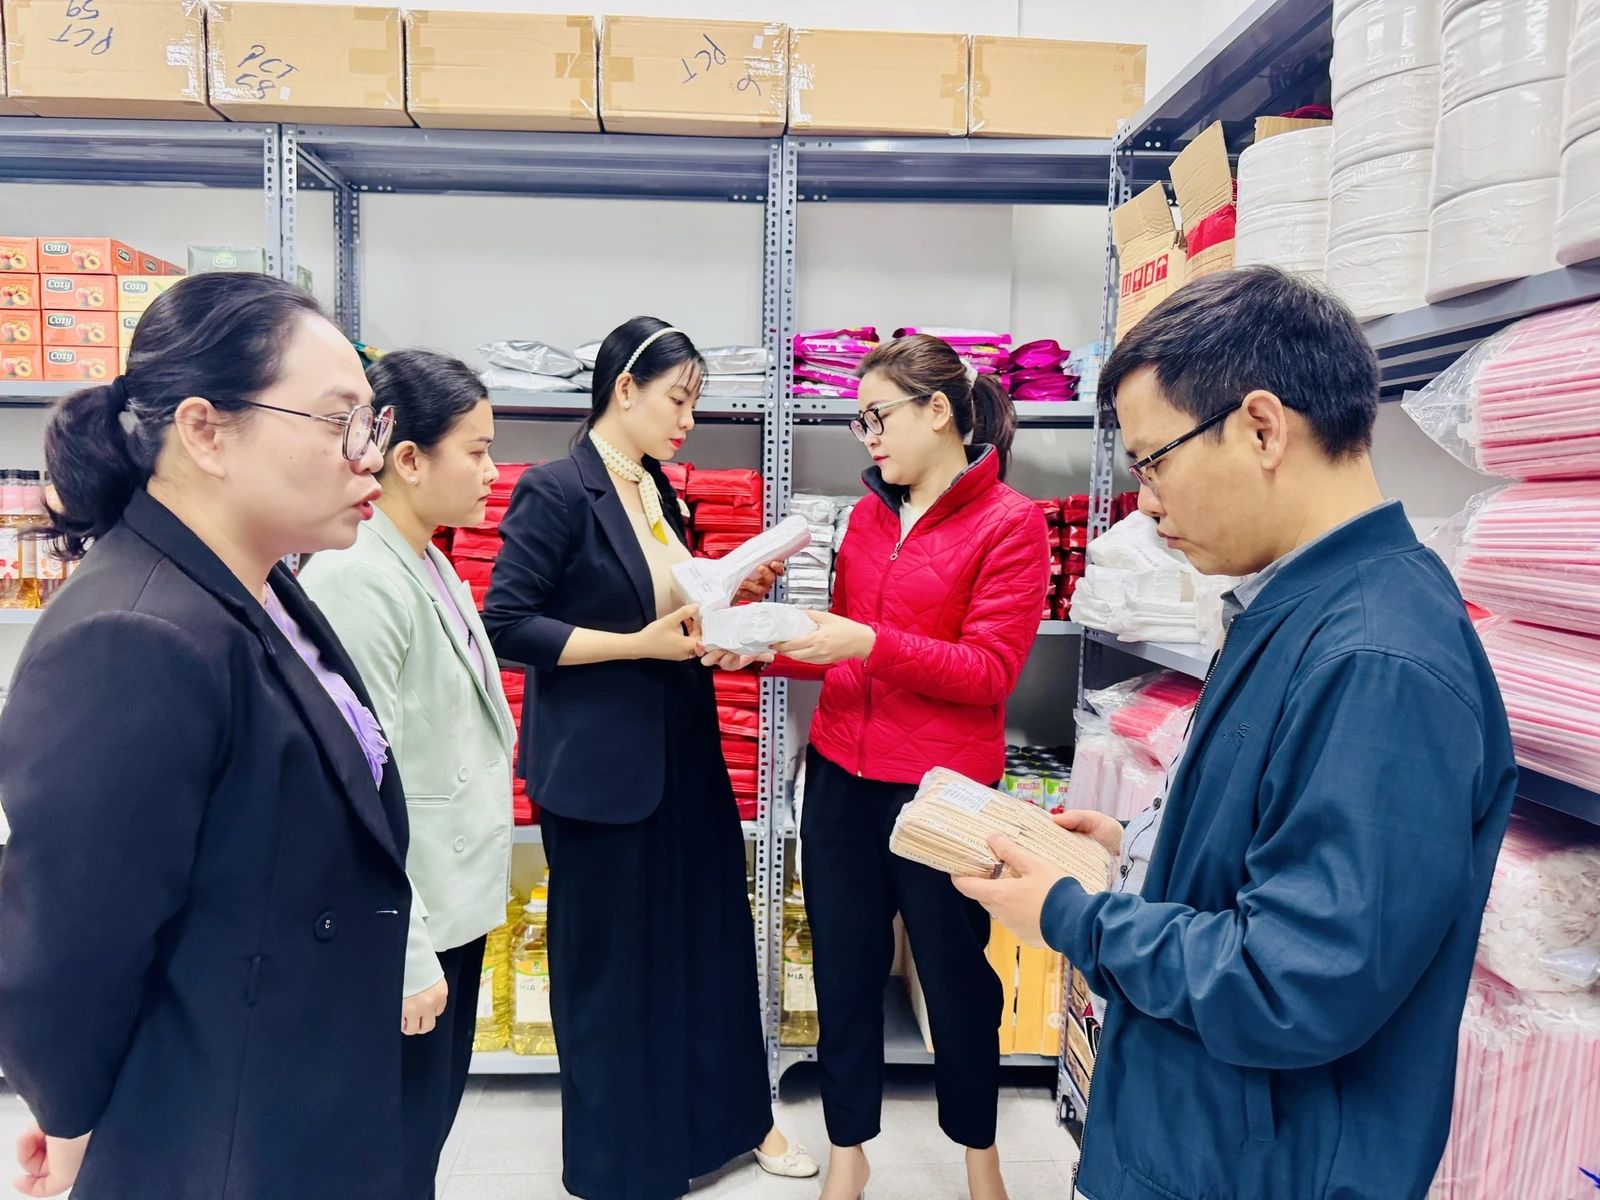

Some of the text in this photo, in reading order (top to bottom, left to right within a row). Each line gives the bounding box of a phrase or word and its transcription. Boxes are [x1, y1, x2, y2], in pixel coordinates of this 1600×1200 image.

[47, 24, 113, 55] PCT
[237, 45, 300, 79] PCT
[681, 33, 726, 84] PCT
[45, 243, 68, 253] Cozy
[215, 257, 234, 265] Cozy
[48, 279, 71, 290] Cozy
[124, 282, 146, 292] Cozy
[49, 315, 72, 326] Cozy
[125, 318, 136, 327] Co
[50, 351, 73, 362] Cozy
[970, 824, 988, 836] COF
[945, 827, 990, 851] HIGHLANDS
[931, 859, 976, 878] IHLANDS
